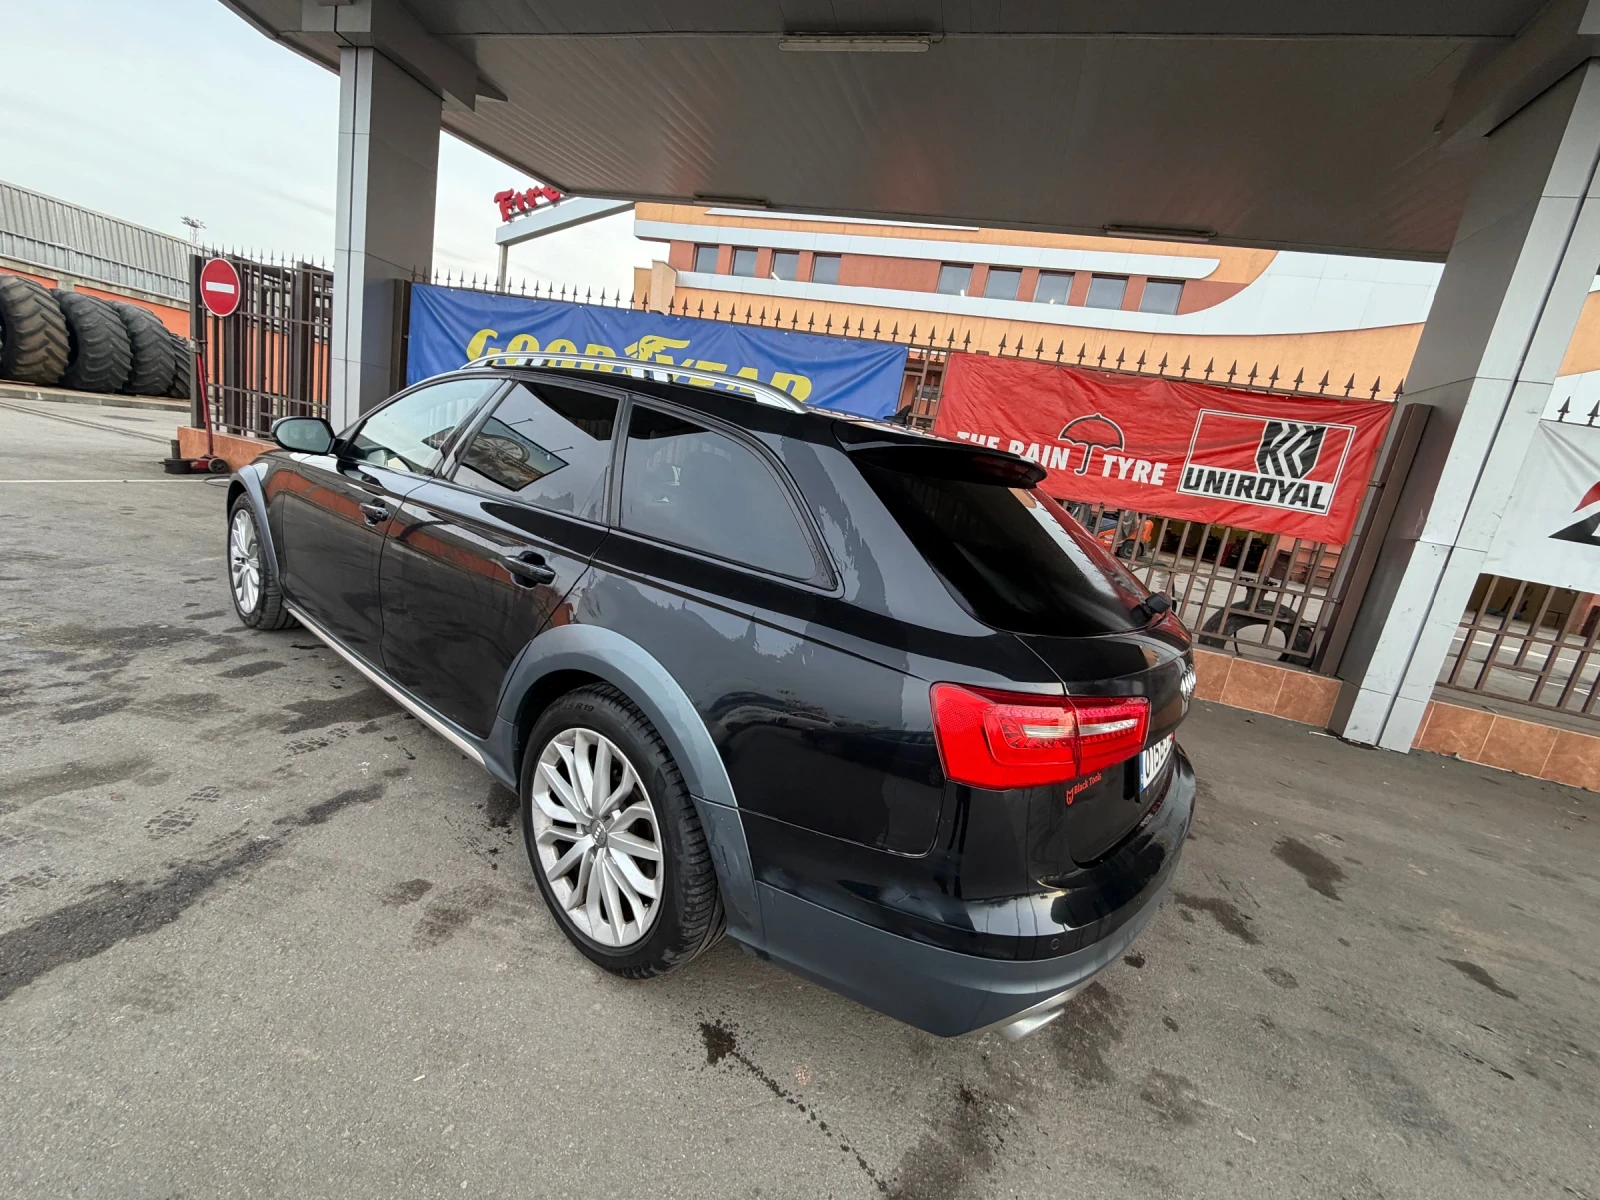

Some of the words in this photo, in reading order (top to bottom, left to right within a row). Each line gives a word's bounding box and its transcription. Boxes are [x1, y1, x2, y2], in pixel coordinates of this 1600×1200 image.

[1008, 439, 1070, 471] RAIN
[1102, 454, 1168, 486] TYRE
[1182, 467, 1326, 510] UNIROYAL
[1074, 779, 1089, 795] Black
[1089, 771, 1102, 786] Tools
